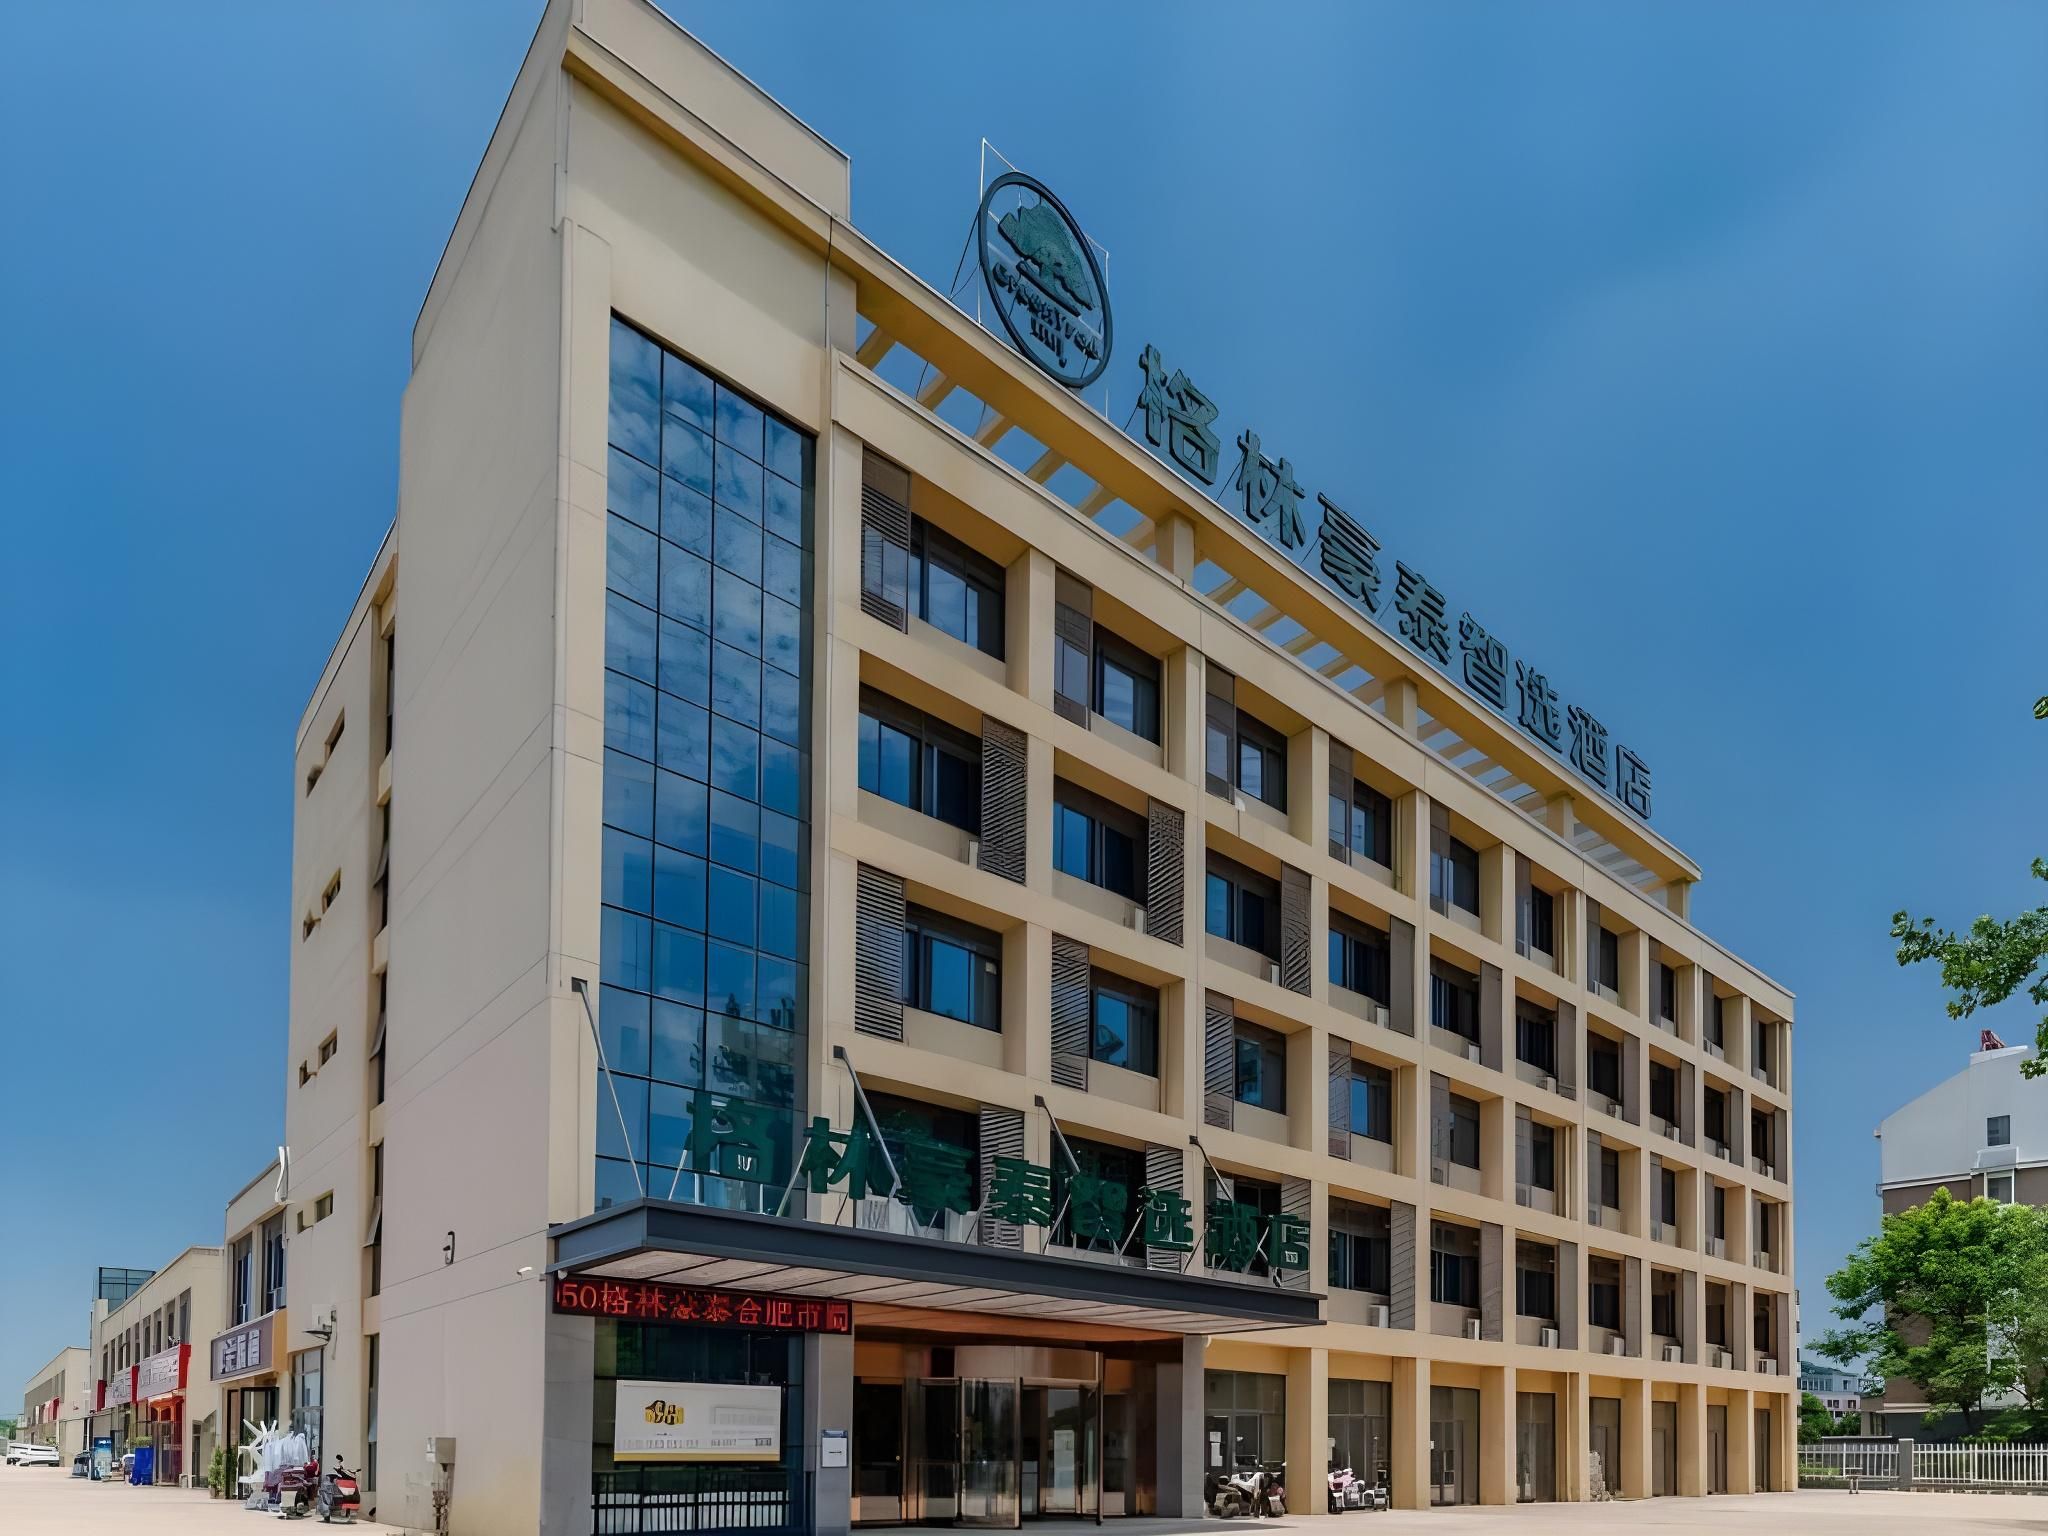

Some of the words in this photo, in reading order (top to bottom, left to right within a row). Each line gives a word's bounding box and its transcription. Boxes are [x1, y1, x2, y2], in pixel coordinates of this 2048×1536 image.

[1138, 343, 1652, 819] 格林豪泰智选酒店
